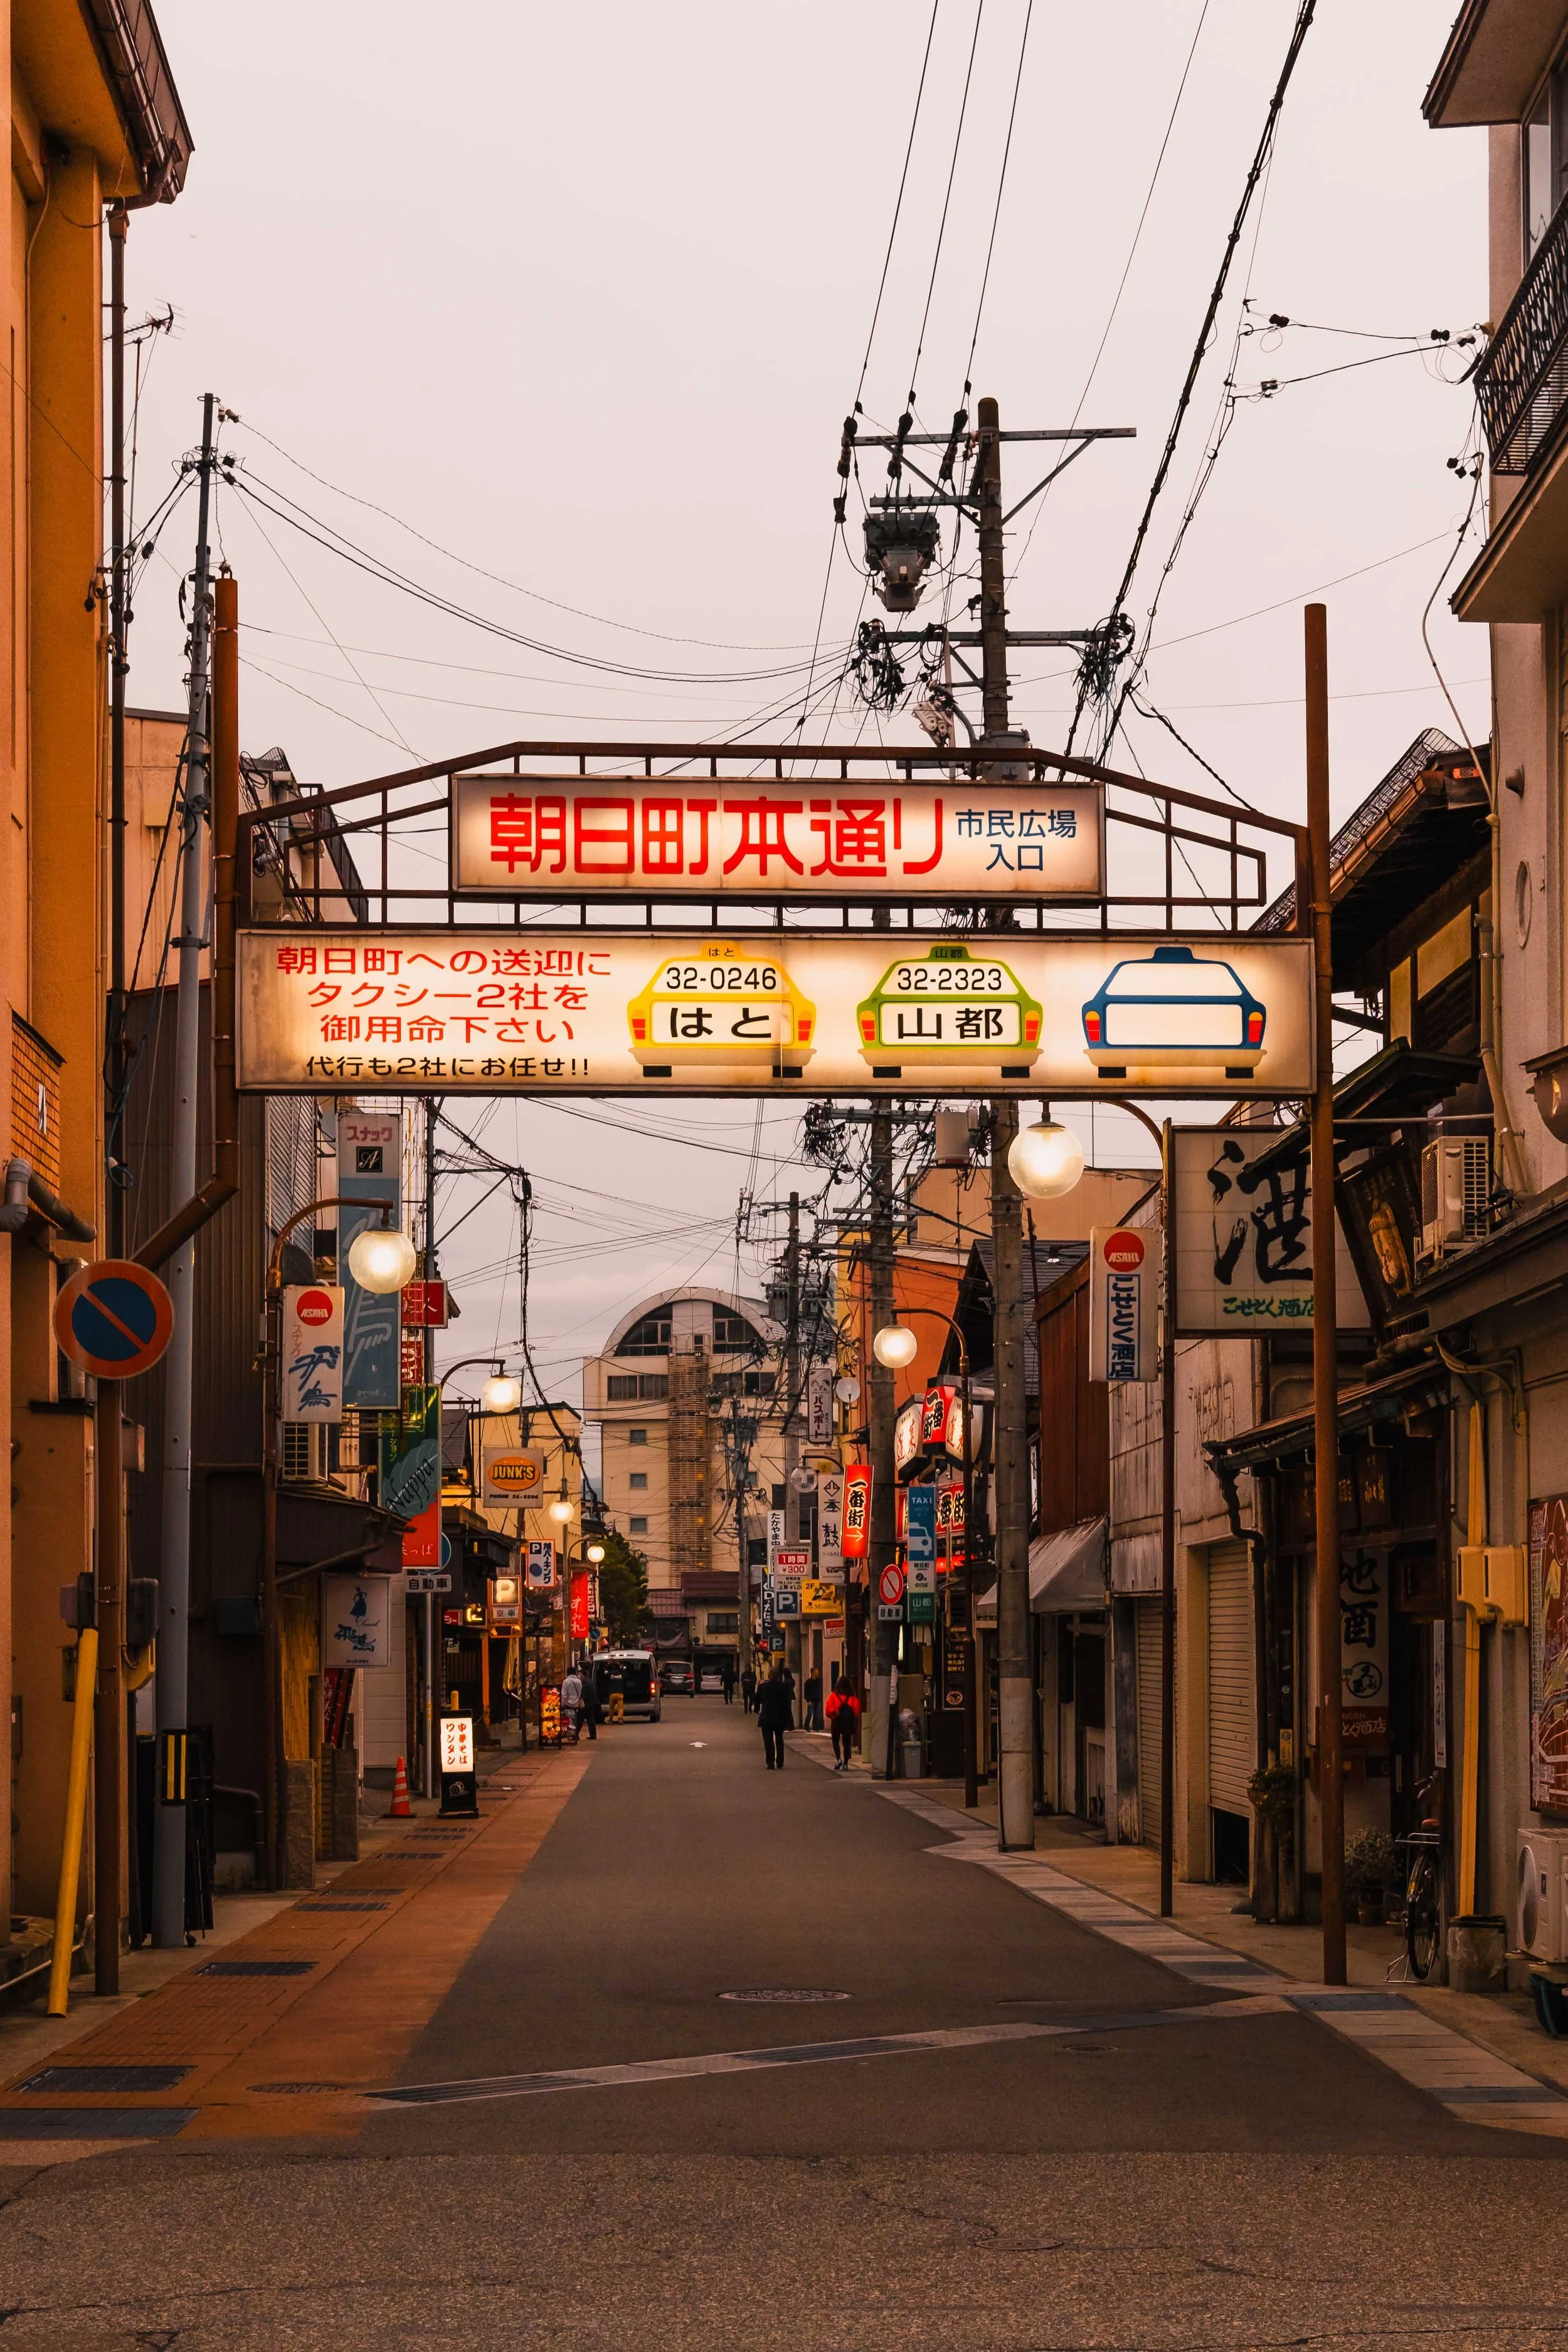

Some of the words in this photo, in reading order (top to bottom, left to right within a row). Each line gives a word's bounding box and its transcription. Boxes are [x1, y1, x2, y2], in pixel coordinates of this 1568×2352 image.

[490, 793, 943, 876] 朝日町本通り
[955, 808, 1078, 839] 市民広場
[987, 844, 1044, 871] 入口
[277, 947, 611, 977] 朝日町への送迎に
[708, 948, 735, 957] はと
[935, 949, 963, 959] 山都
[666, 967, 777, 990] 32-0246
[897, 968, 1002, 990] 32-2323
[308, 982, 589, 1010] タクシー2社を
[321, 1014, 575, 1044] 御用命下さい
[670, 1007, 773, 1039] はと
[898, 1007, 1004, 1039] 山都
[307, 1056, 590, 1078] 代行も2社にお任せ!!
[346, 1126, 393, 1142] スナック
[1108, 1252, 1140, 1263] ASAHI
[300, 1308, 329, 1318] ASAHI
[1110, 1276, 1136, 1377] こせとく酒店
[813, 1394, 825, 1438] パスポート
[492, 1465, 536, 1480] JUNK'S
[847, 1480, 868, 1528] 一番街
[532, 1544, 541, 1553] P
[782, 1555, 805, 1564] 1時間
[409, 1578, 448, 1590] 自動車
[495, 1579, 515, 1602] P
[778, 1594, 794, 1609] P
